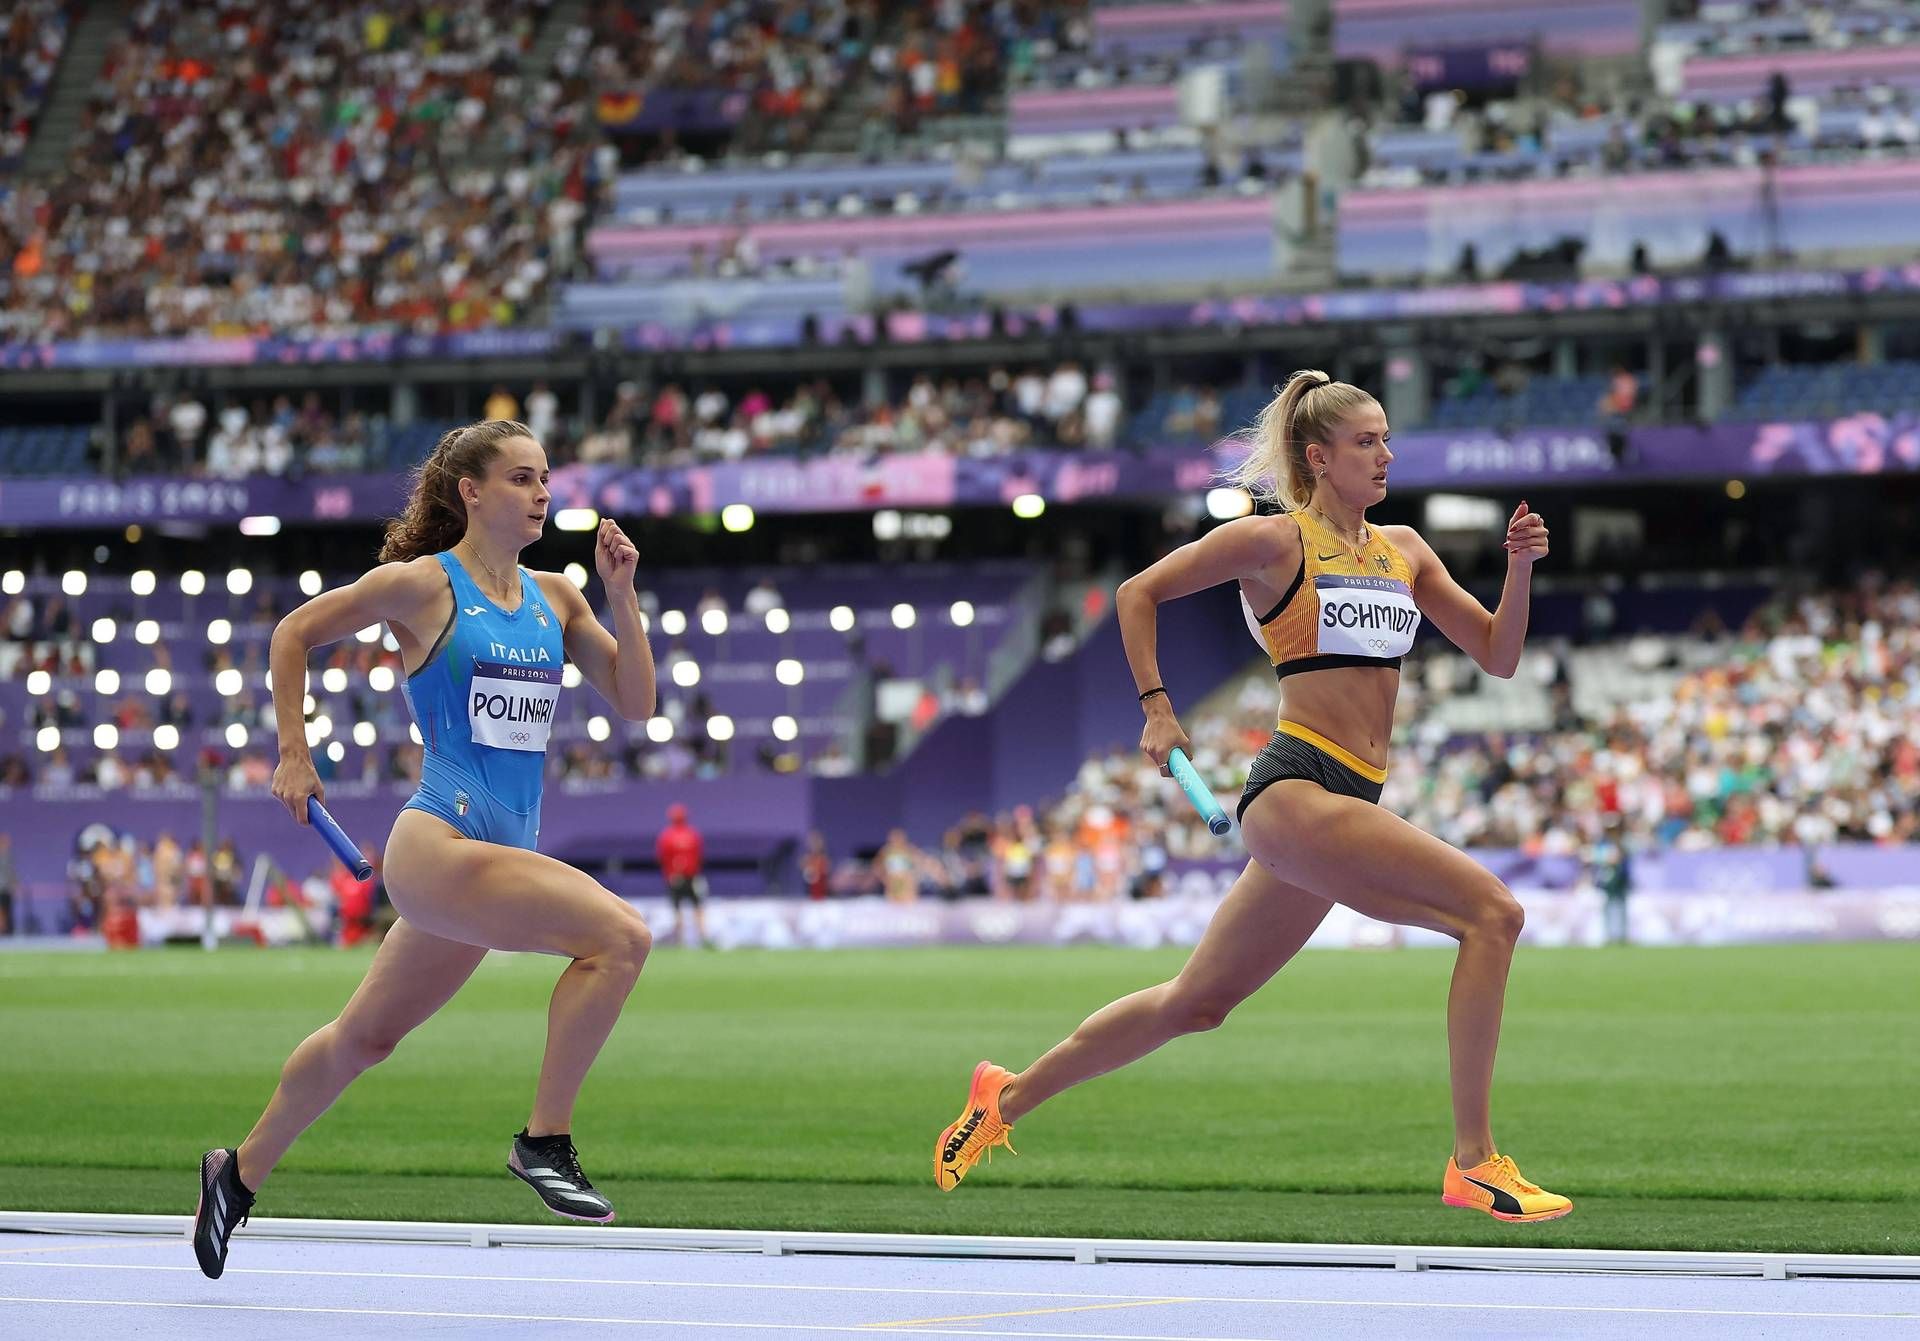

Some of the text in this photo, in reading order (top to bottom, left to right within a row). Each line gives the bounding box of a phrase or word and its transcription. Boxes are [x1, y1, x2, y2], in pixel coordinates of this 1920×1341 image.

[60, 483, 155, 517] PARIS
[1344, 578, 1395, 589] PARIS 2024
[1323, 602, 1417, 634] SCHMIDT
[490, 642, 550, 662] ITALIA
[502, 667, 549, 679] PARIS 2024
[473, 692, 554, 723] POLINARI
[943, 1105, 988, 1163] NITRO
